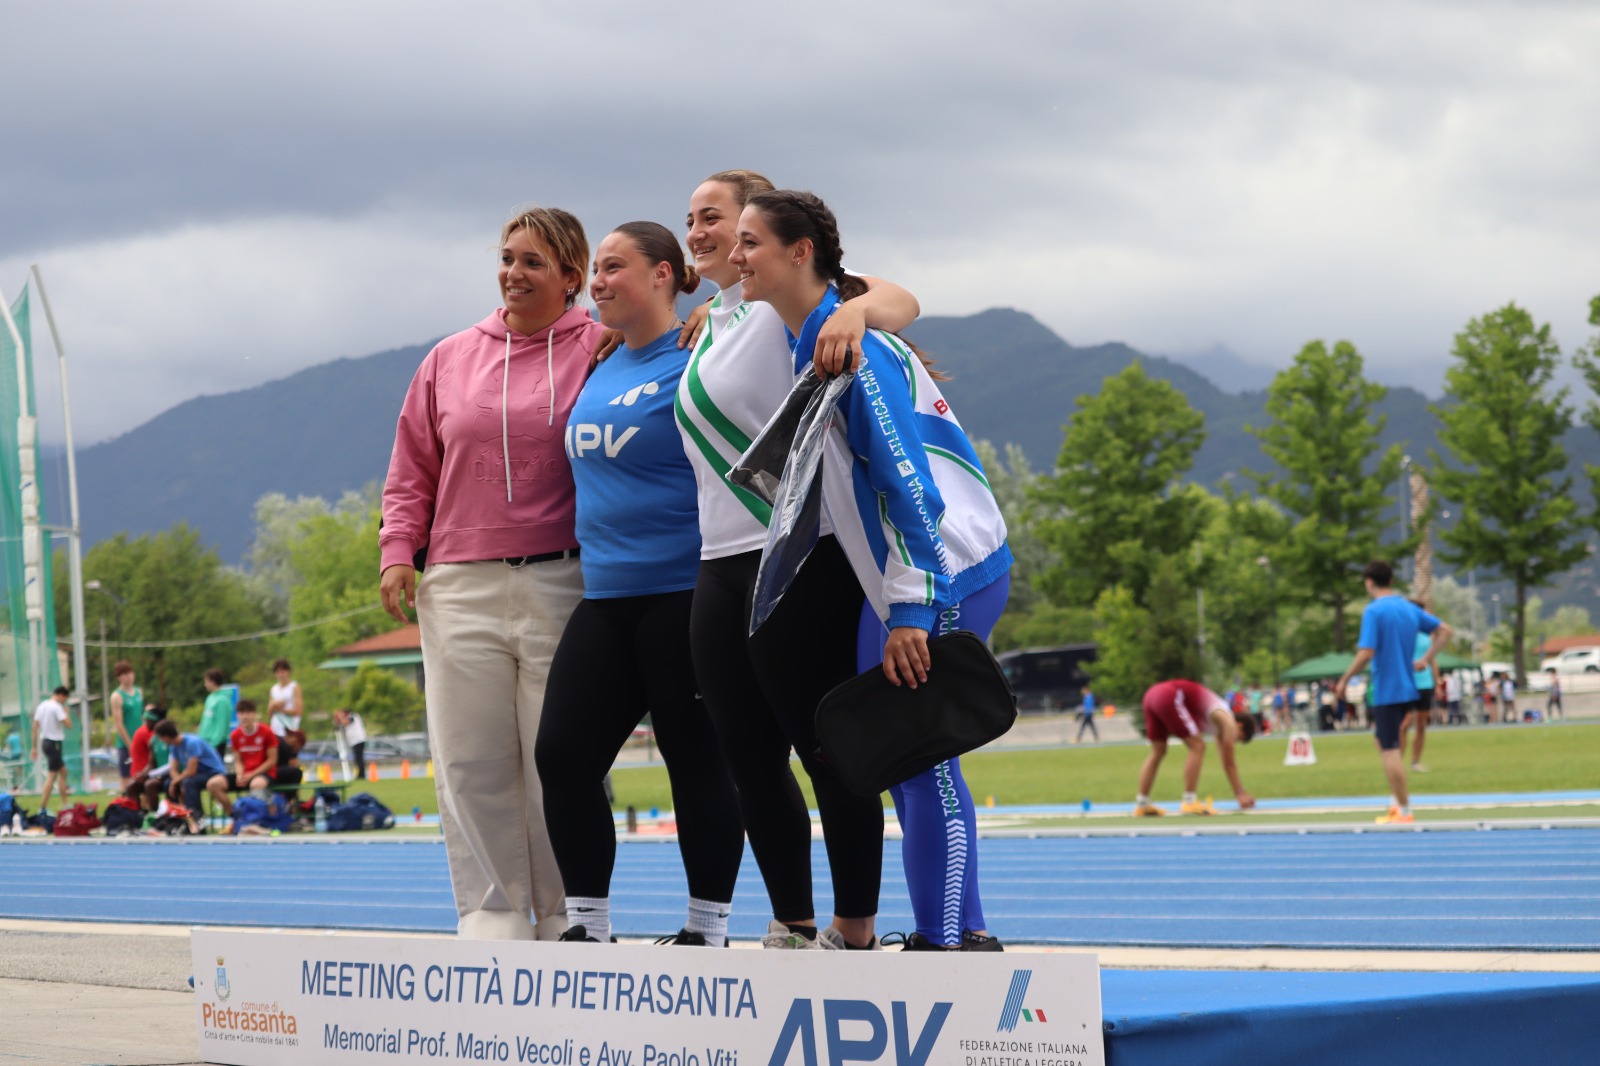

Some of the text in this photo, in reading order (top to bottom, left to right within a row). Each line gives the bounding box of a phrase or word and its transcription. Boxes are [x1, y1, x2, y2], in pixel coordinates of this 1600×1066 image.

[871, 396, 906, 457] ATLETICA
[301, 957, 758, 1019] MEETING CITTÀ DI PIETRASANTA
[202, 1002, 298, 1035] Pietrasanta
[240, 1002, 279, 1013] comune di
[204, 1031, 218, 1040] Città
[240, 1034, 254, 1043] Città
[323, 1023, 738, 1066] Memorial Prof. Mario Vecoli e Avv Paolo Viti
[767, 997, 953, 1066] APV
[959, 1040, 1088, 1055] FEDERAZIONE ITALIANA
[965, 1056, 977, 1066] DI
[980, 1057, 1031, 1066] ATLETICA
